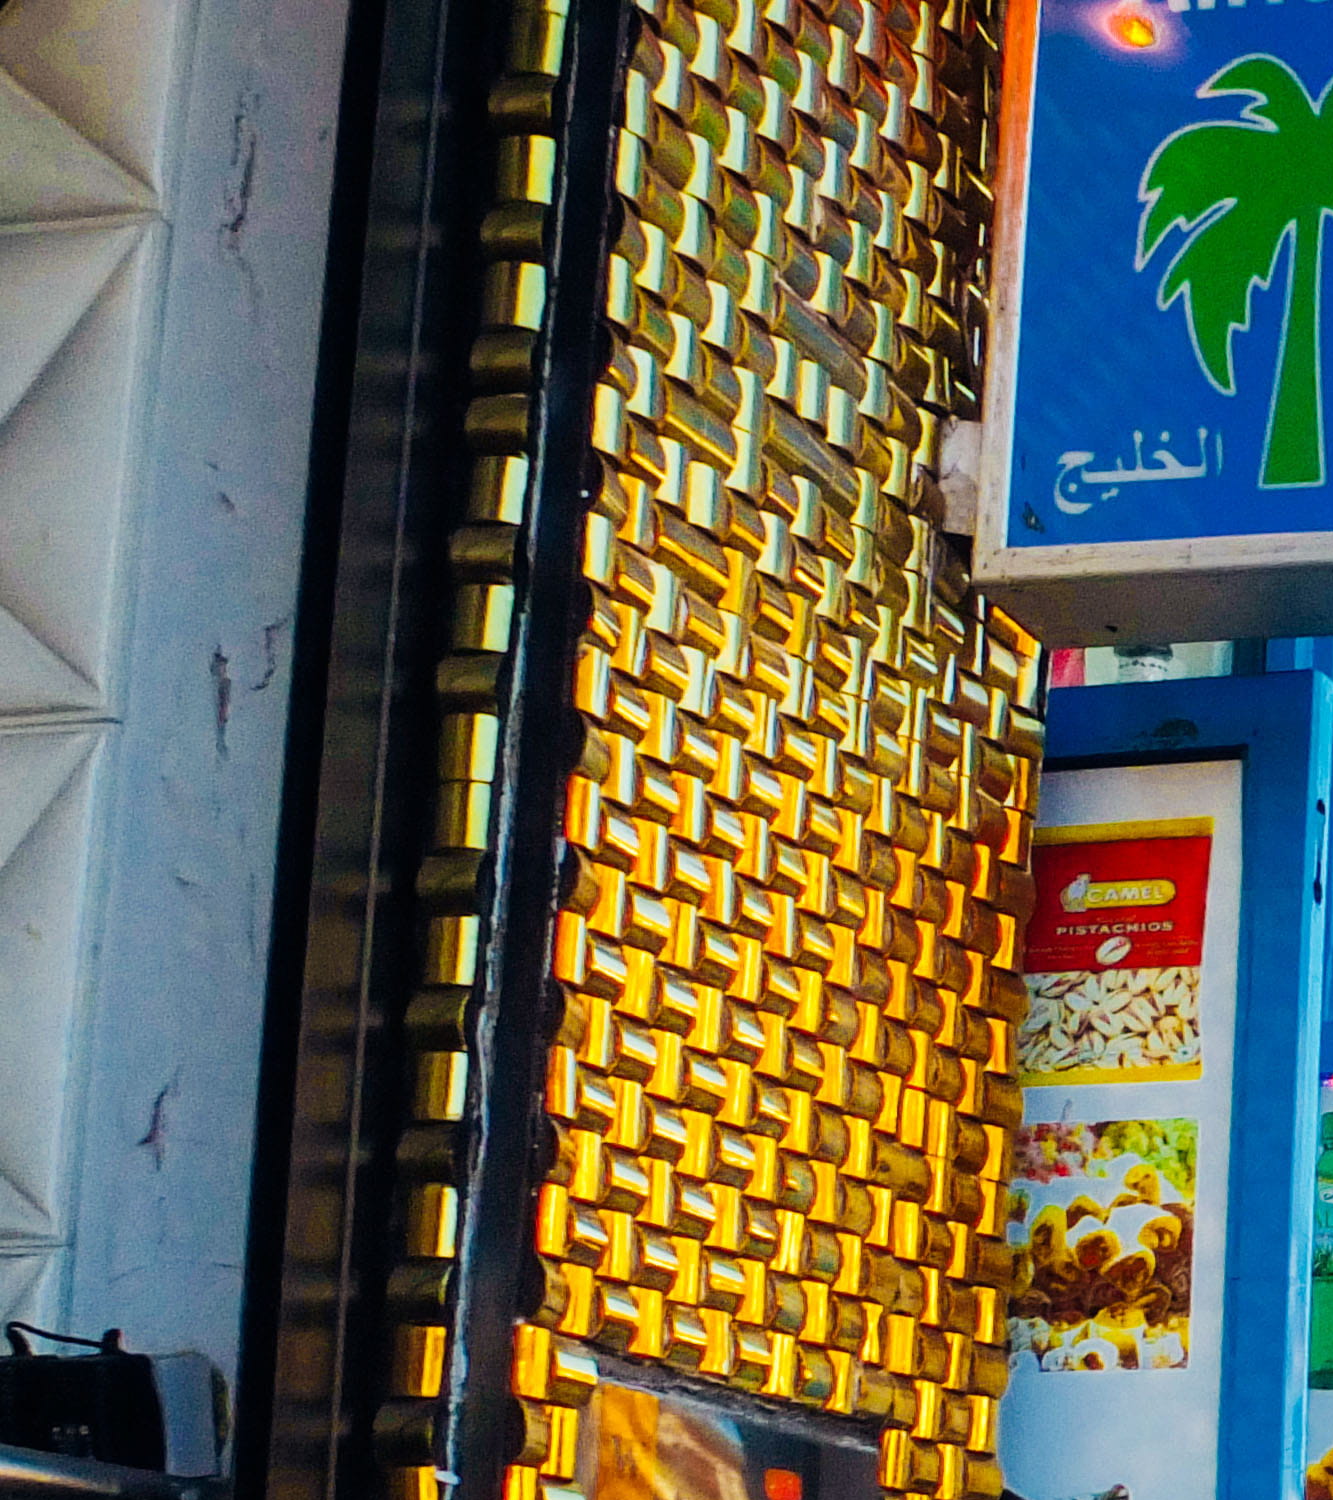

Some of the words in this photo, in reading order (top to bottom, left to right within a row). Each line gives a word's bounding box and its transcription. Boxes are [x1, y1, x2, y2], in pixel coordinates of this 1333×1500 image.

[1053, 427, 1223, 515] الخليج
[1087, 888, 1165, 902] CAMEL
[1056, 920, 1174, 936] PISTACHIOS
